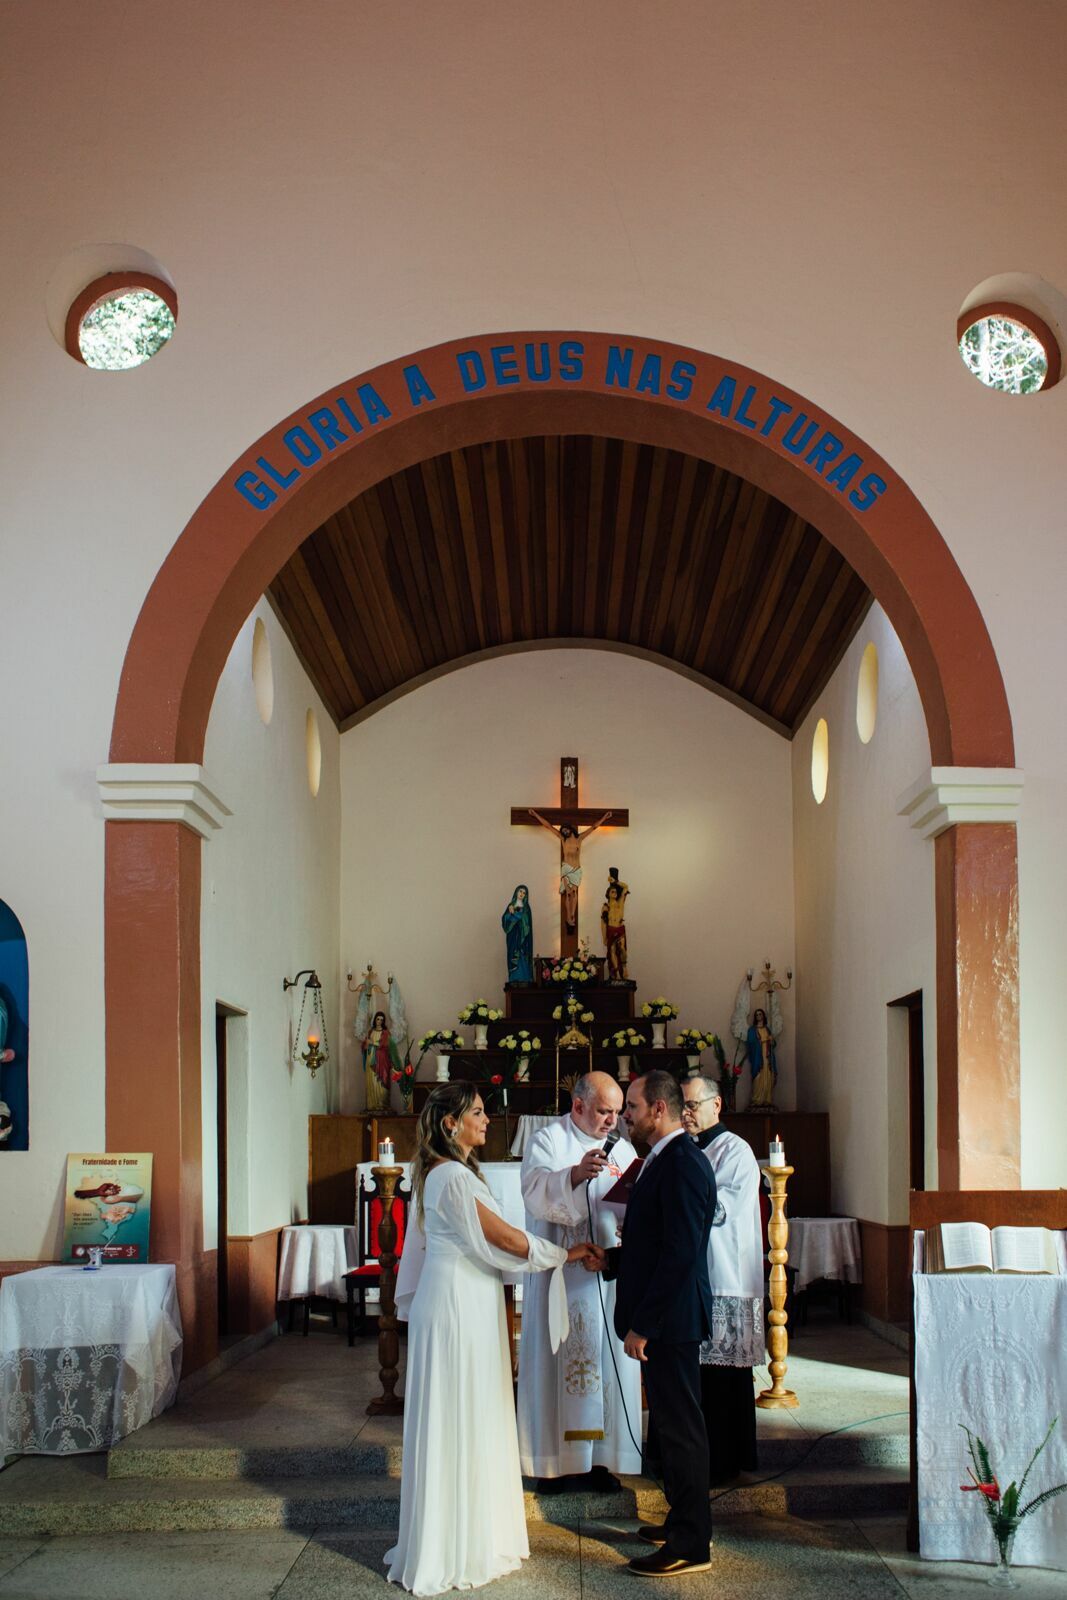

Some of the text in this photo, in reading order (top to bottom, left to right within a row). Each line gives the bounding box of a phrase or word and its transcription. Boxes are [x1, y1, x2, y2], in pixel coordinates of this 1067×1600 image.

[234, 341, 887, 512] GLORIA A DEUS NAS ALTURAS
[82, 1158, 117, 1166] Fraternidade
[123, 1158, 138, 1166] Fome
